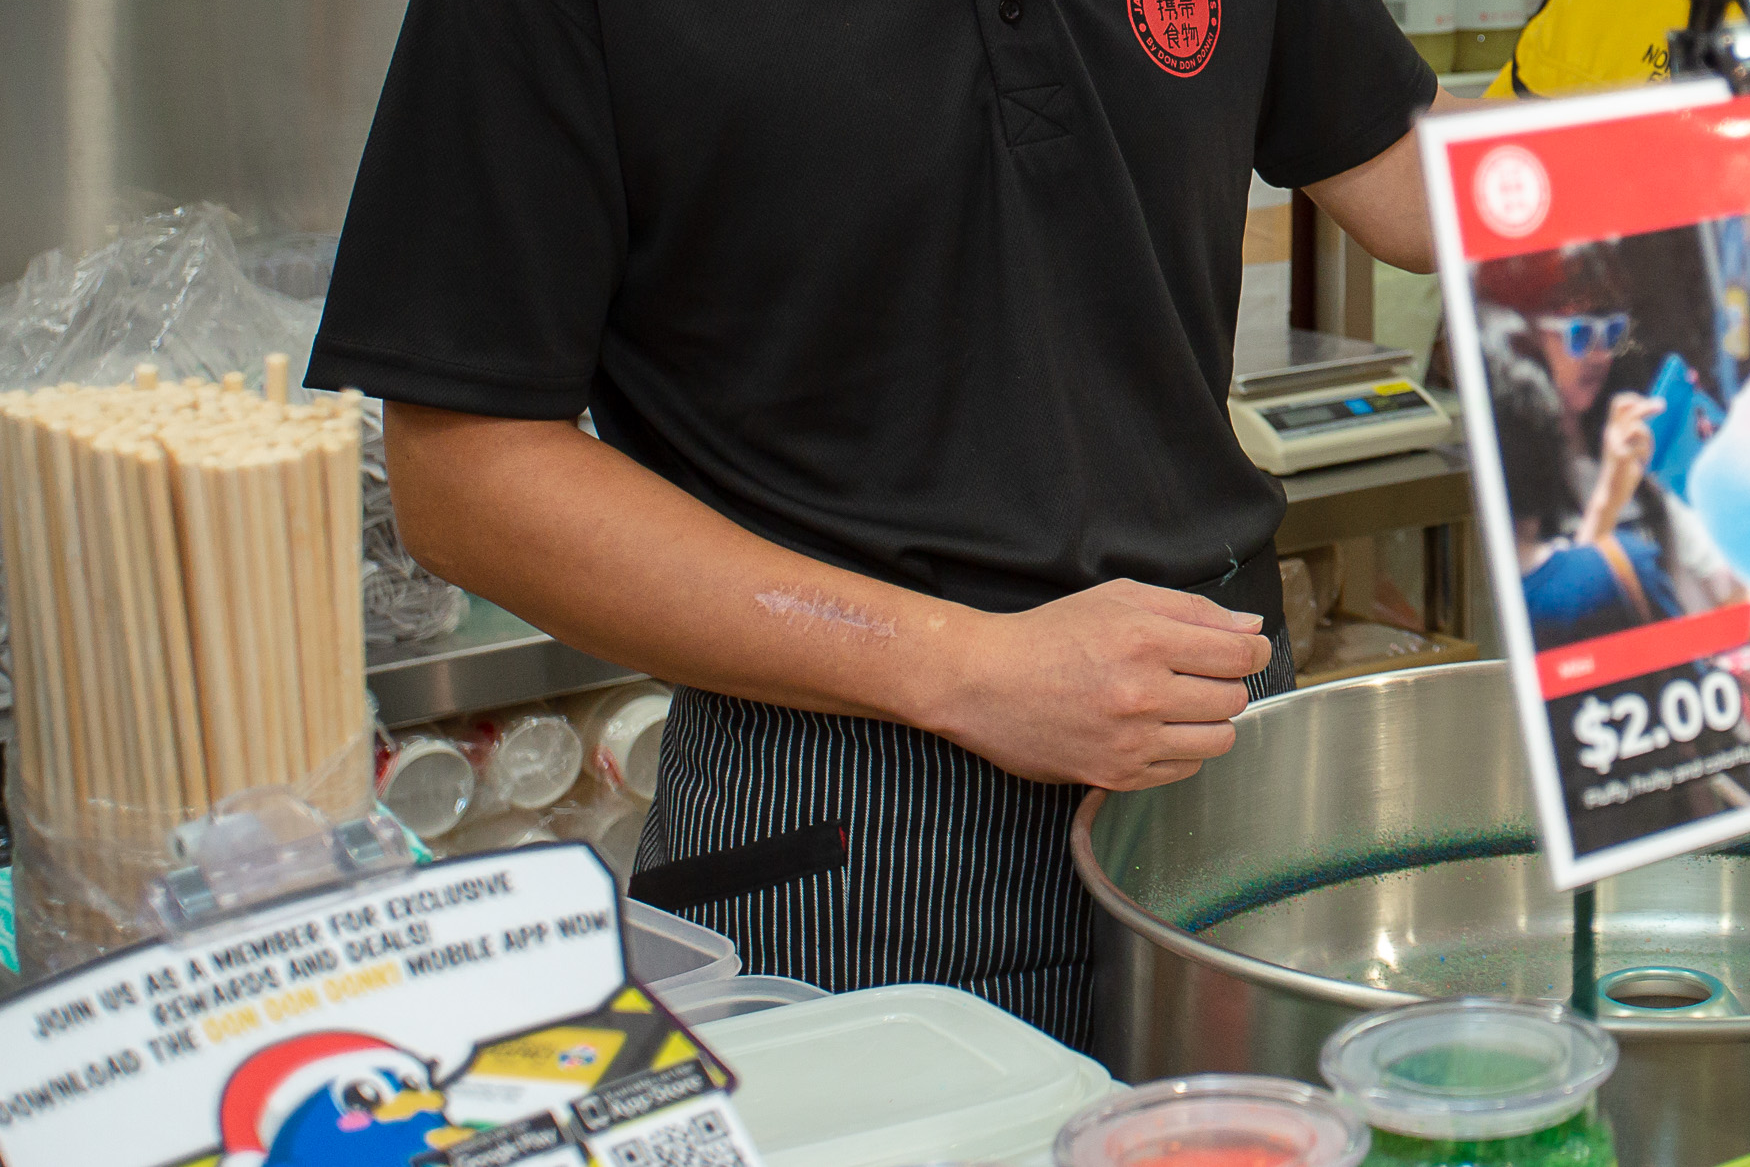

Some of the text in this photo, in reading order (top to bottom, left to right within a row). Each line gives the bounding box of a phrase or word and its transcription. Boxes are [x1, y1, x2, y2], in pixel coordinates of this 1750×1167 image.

[1157, 50, 1177, 69] DON
[1179, 58, 1196, 70] DON
[1197, 32, 1215, 63] DONKI
[1163, 22, 1200, 49] 食物
[1572, 672, 1742, 775] $2.00
[33, 871, 513, 1038] JOIN US AS A MEMBER FOR EXCLUSIVE
[148, 1028, 198, 1062] THE
[405, 935, 493, 978] MOBILE
[502, 922, 549, 952] APP
[151, 965, 279, 1026] REWARDS
[287, 948, 338, 980] AND
